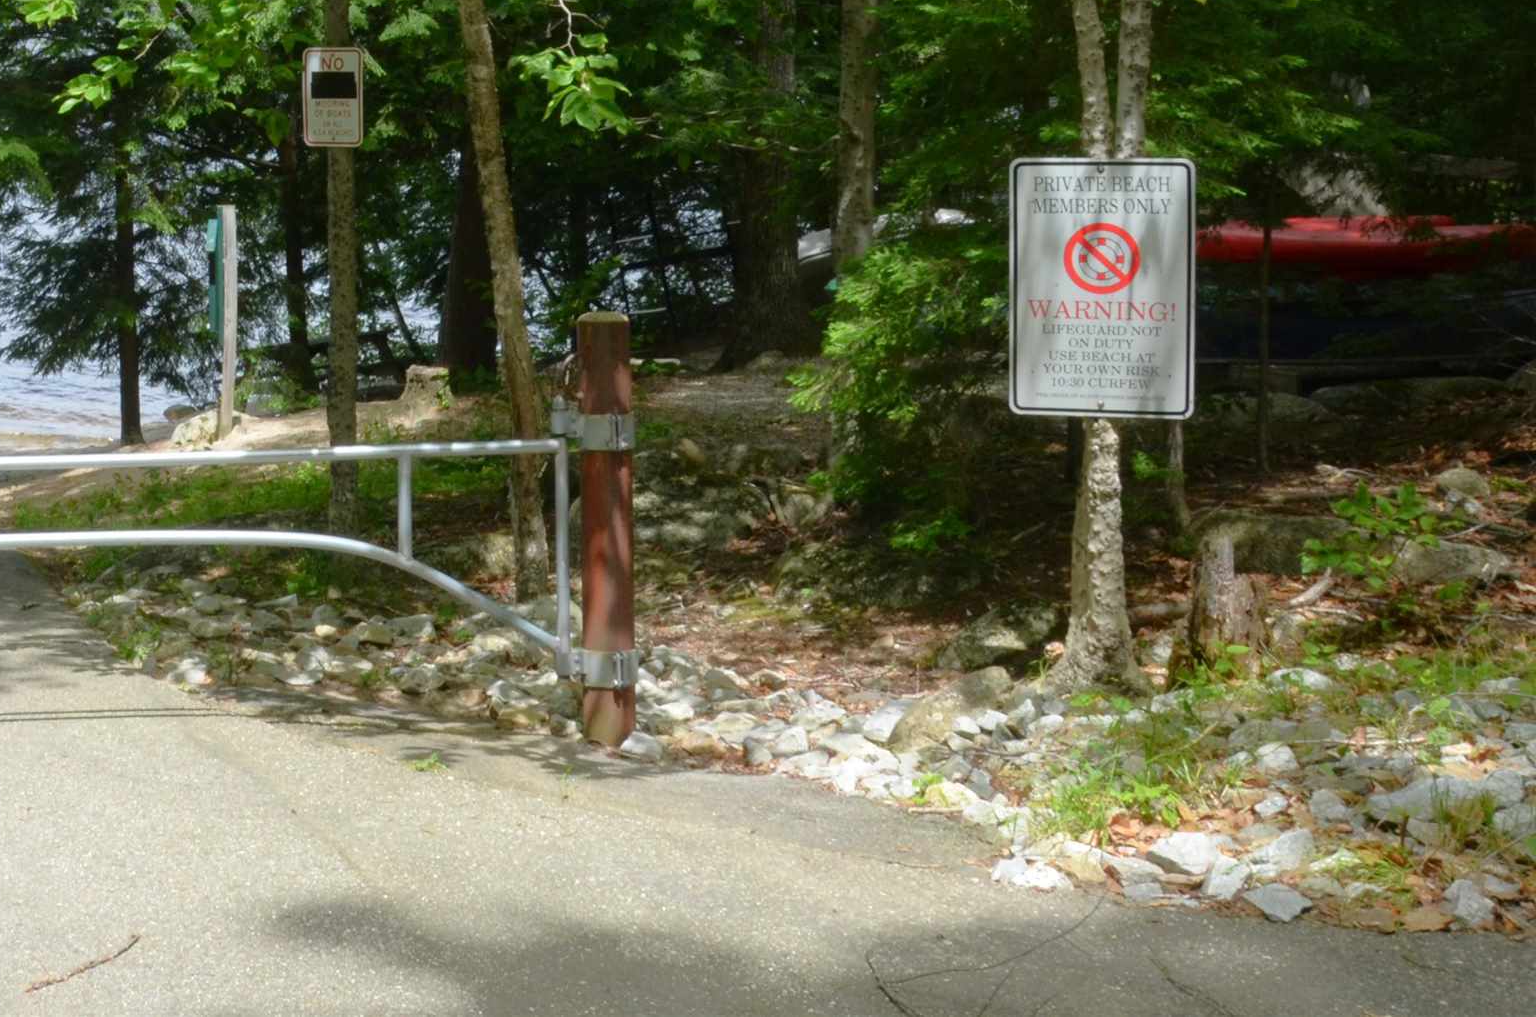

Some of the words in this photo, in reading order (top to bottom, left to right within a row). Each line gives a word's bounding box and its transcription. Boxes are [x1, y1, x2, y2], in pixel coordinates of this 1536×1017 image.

[321, 58, 344, 71] NO
[1033, 176, 1107, 192] PRIVATE
[1112, 176, 1171, 193] BEACH
[1033, 198, 1118, 214] MEMBERS
[1123, 198, 1171, 215] ONLY
[1028, 299, 1176, 322] WARNING!
[1042, 324, 1127, 336] LIFEGUARD
[1131, 326, 1162, 337] NOT
[1068, 338, 1089, 348] ON
[1094, 338, 1134, 349] DUTY
[1048, 350, 1077, 361] USE
[1081, 351, 1131, 362] BEACH
[1136, 353, 1156, 363] AT
[1043, 363, 1083, 374] YOUR
[1086, 364, 1122, 375] OWN
[1125, 365, 1160, 377] RISK
[1088, 378, 1152, 390] CURFEW
